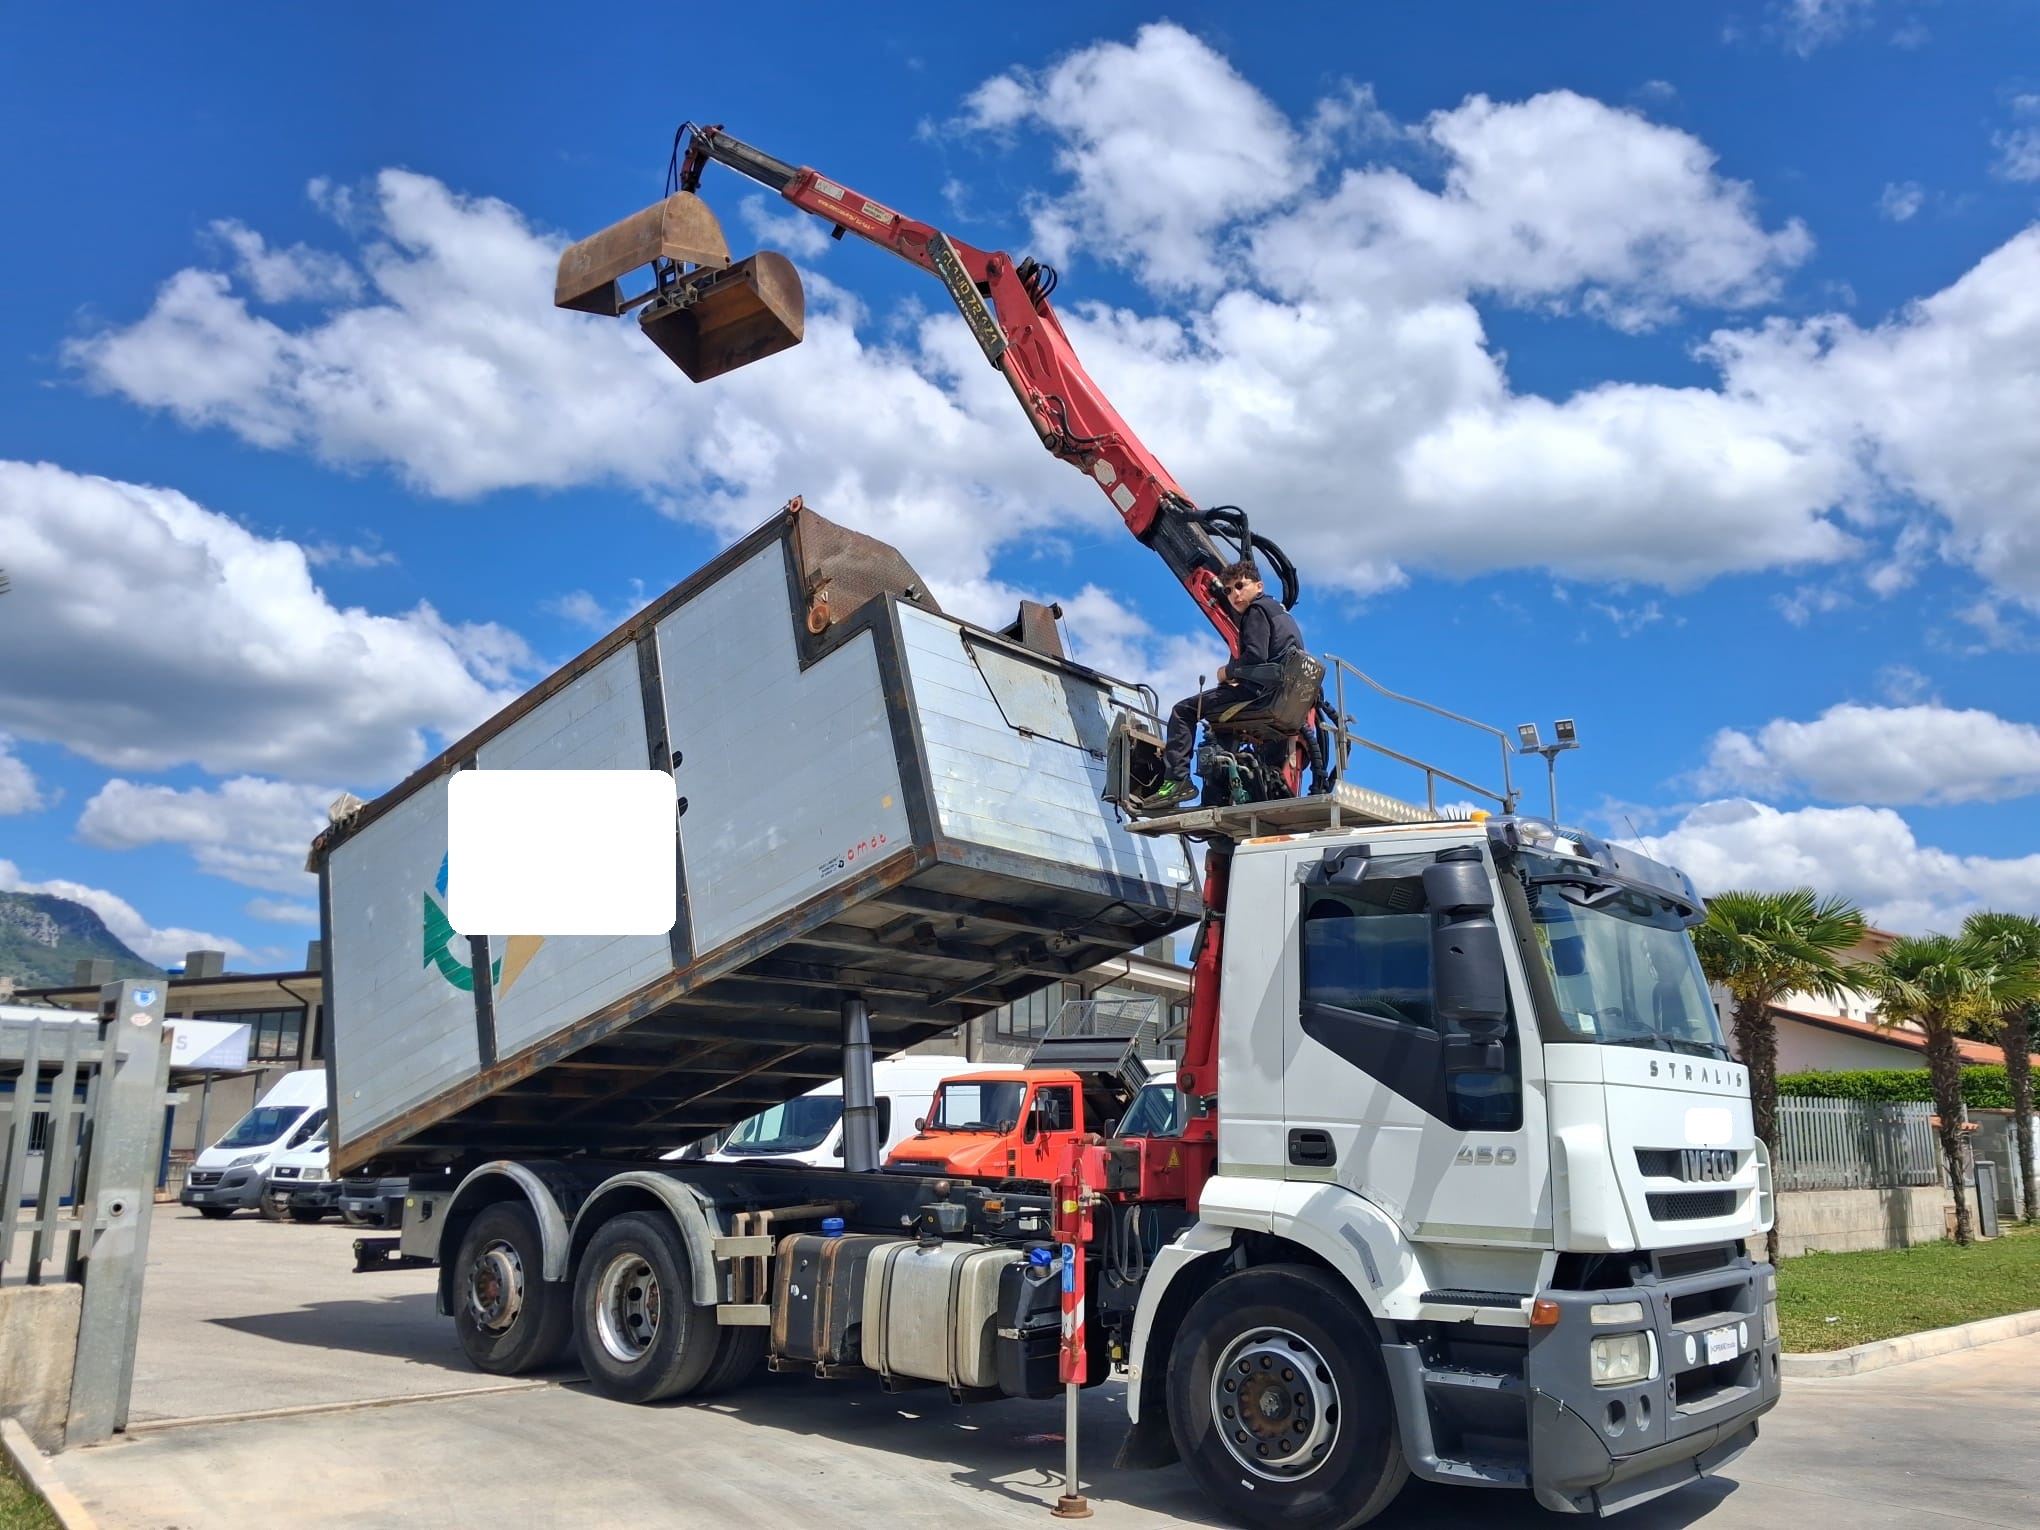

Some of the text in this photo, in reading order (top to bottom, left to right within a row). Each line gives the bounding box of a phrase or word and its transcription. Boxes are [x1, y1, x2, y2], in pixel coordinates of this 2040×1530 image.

[1650, 1060, 1742, 1087] STRALIS
[1454, 1145, 1517, 1166] 450
[1681, 1149, 1734, 1183] IVECO
